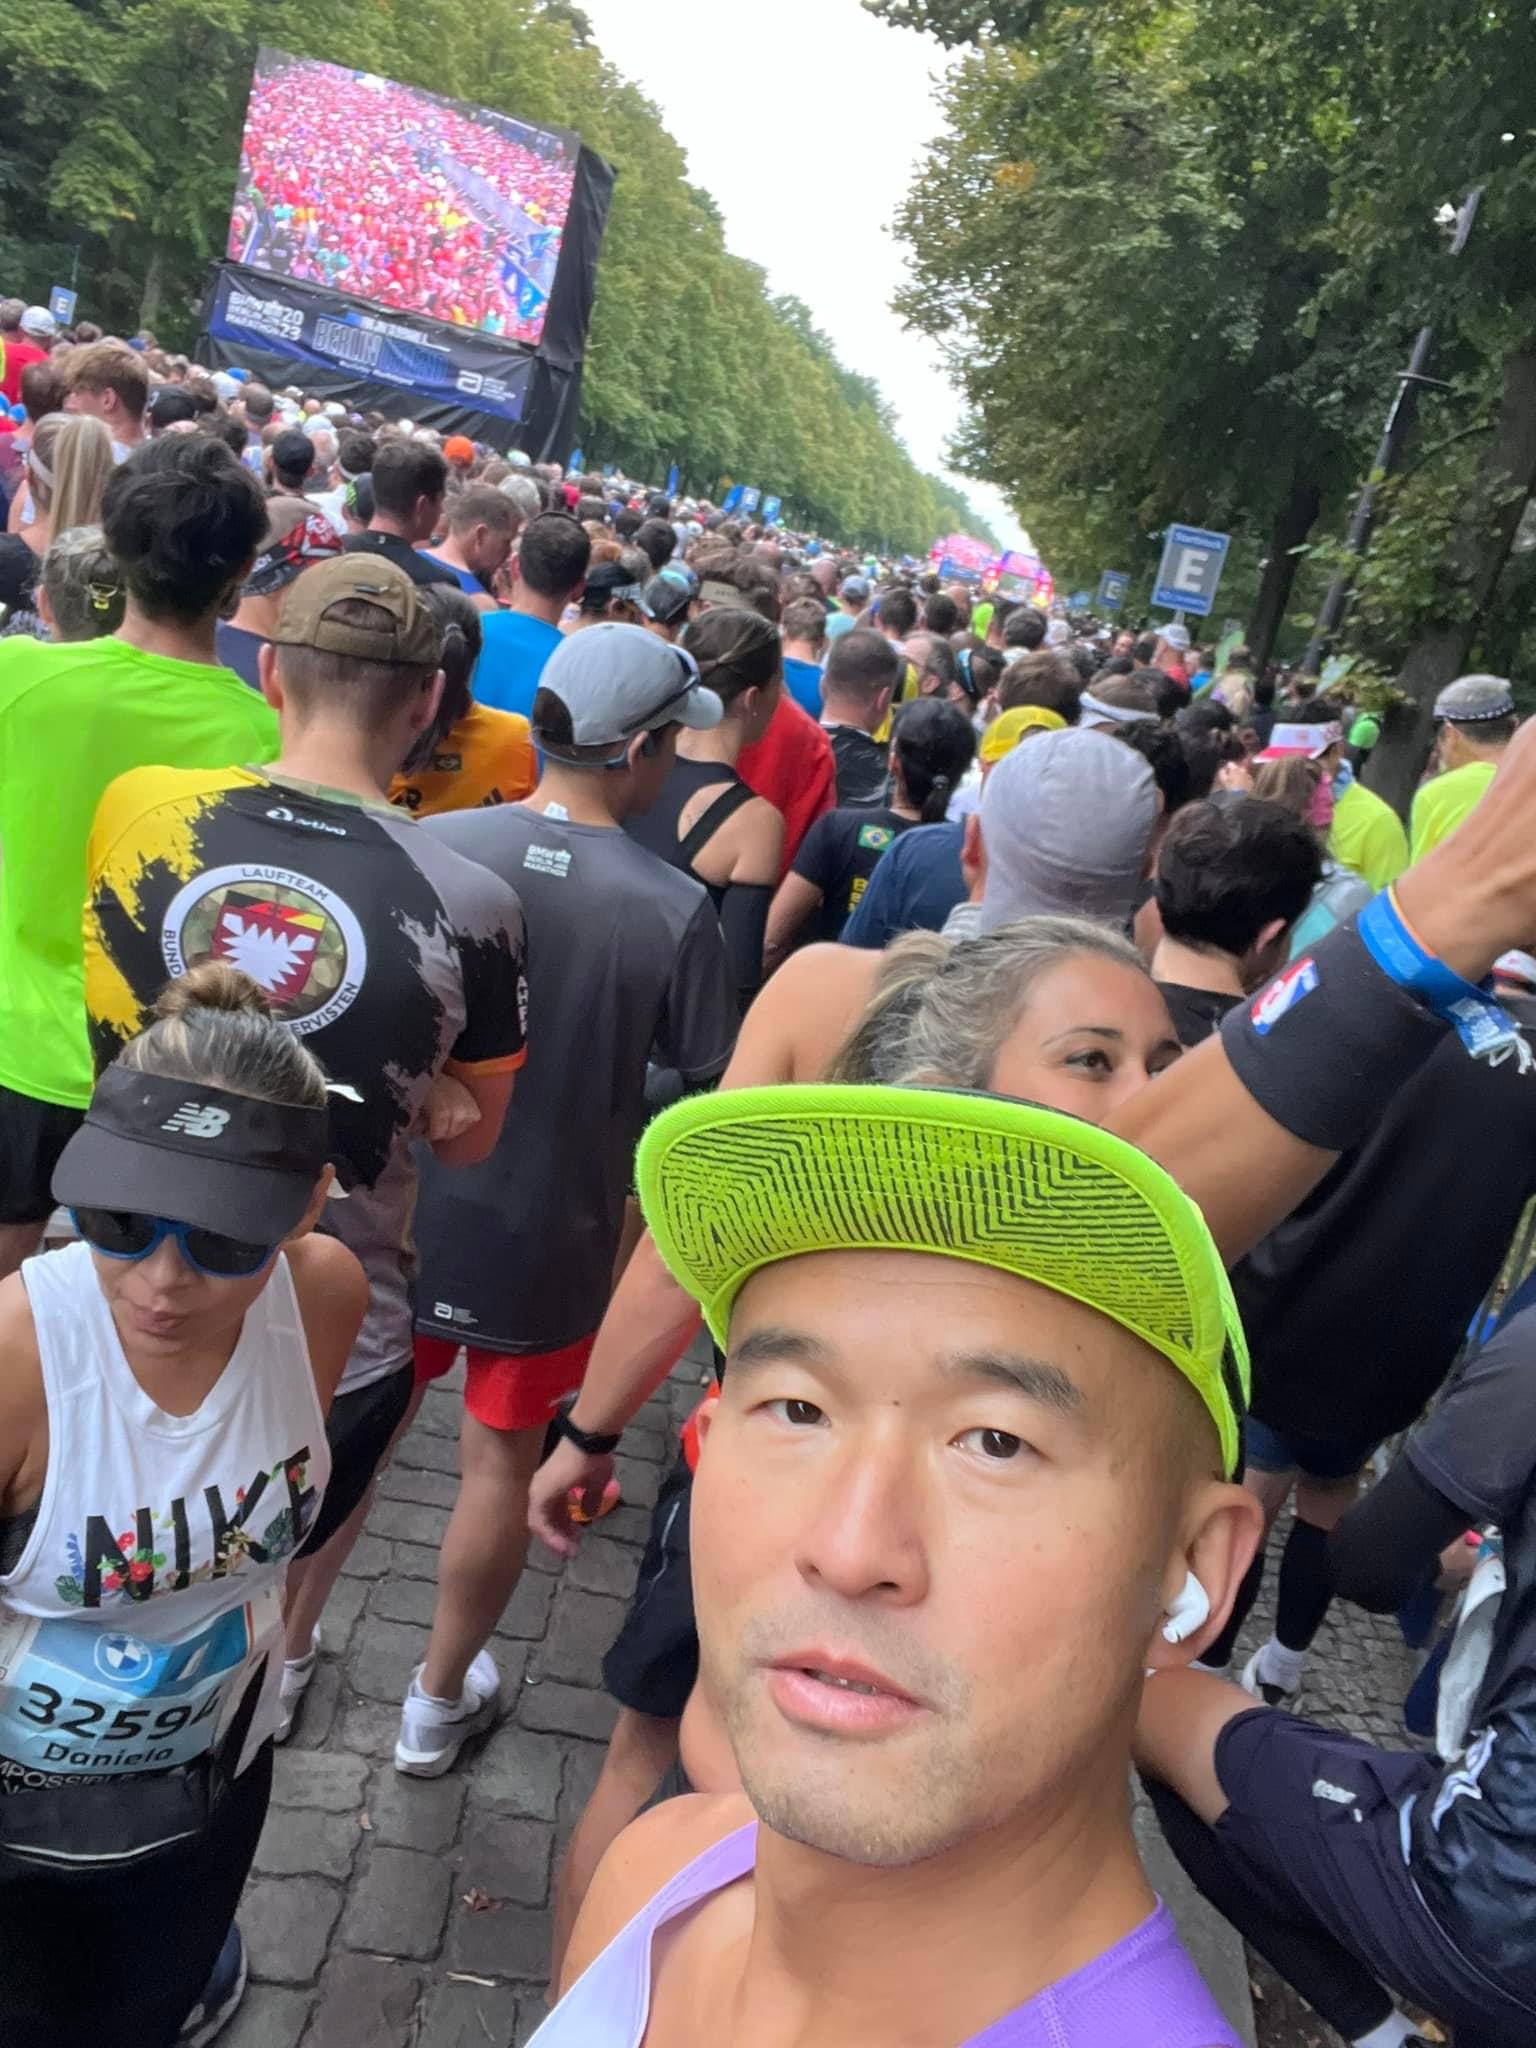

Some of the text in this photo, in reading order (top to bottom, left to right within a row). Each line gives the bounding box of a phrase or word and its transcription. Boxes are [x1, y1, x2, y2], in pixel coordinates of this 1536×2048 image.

[283, 308, 304, 326] 20
[280, 323, 302, 341] 23
[1173, 548, 1209, 592] E
[1105, 580, 1121, 600] E
[241, 867, 329, 901] LAUFTEAM
[83, 1446, 318, 1608] NIKE
[43, 1742, 174, 1767] Daniela
